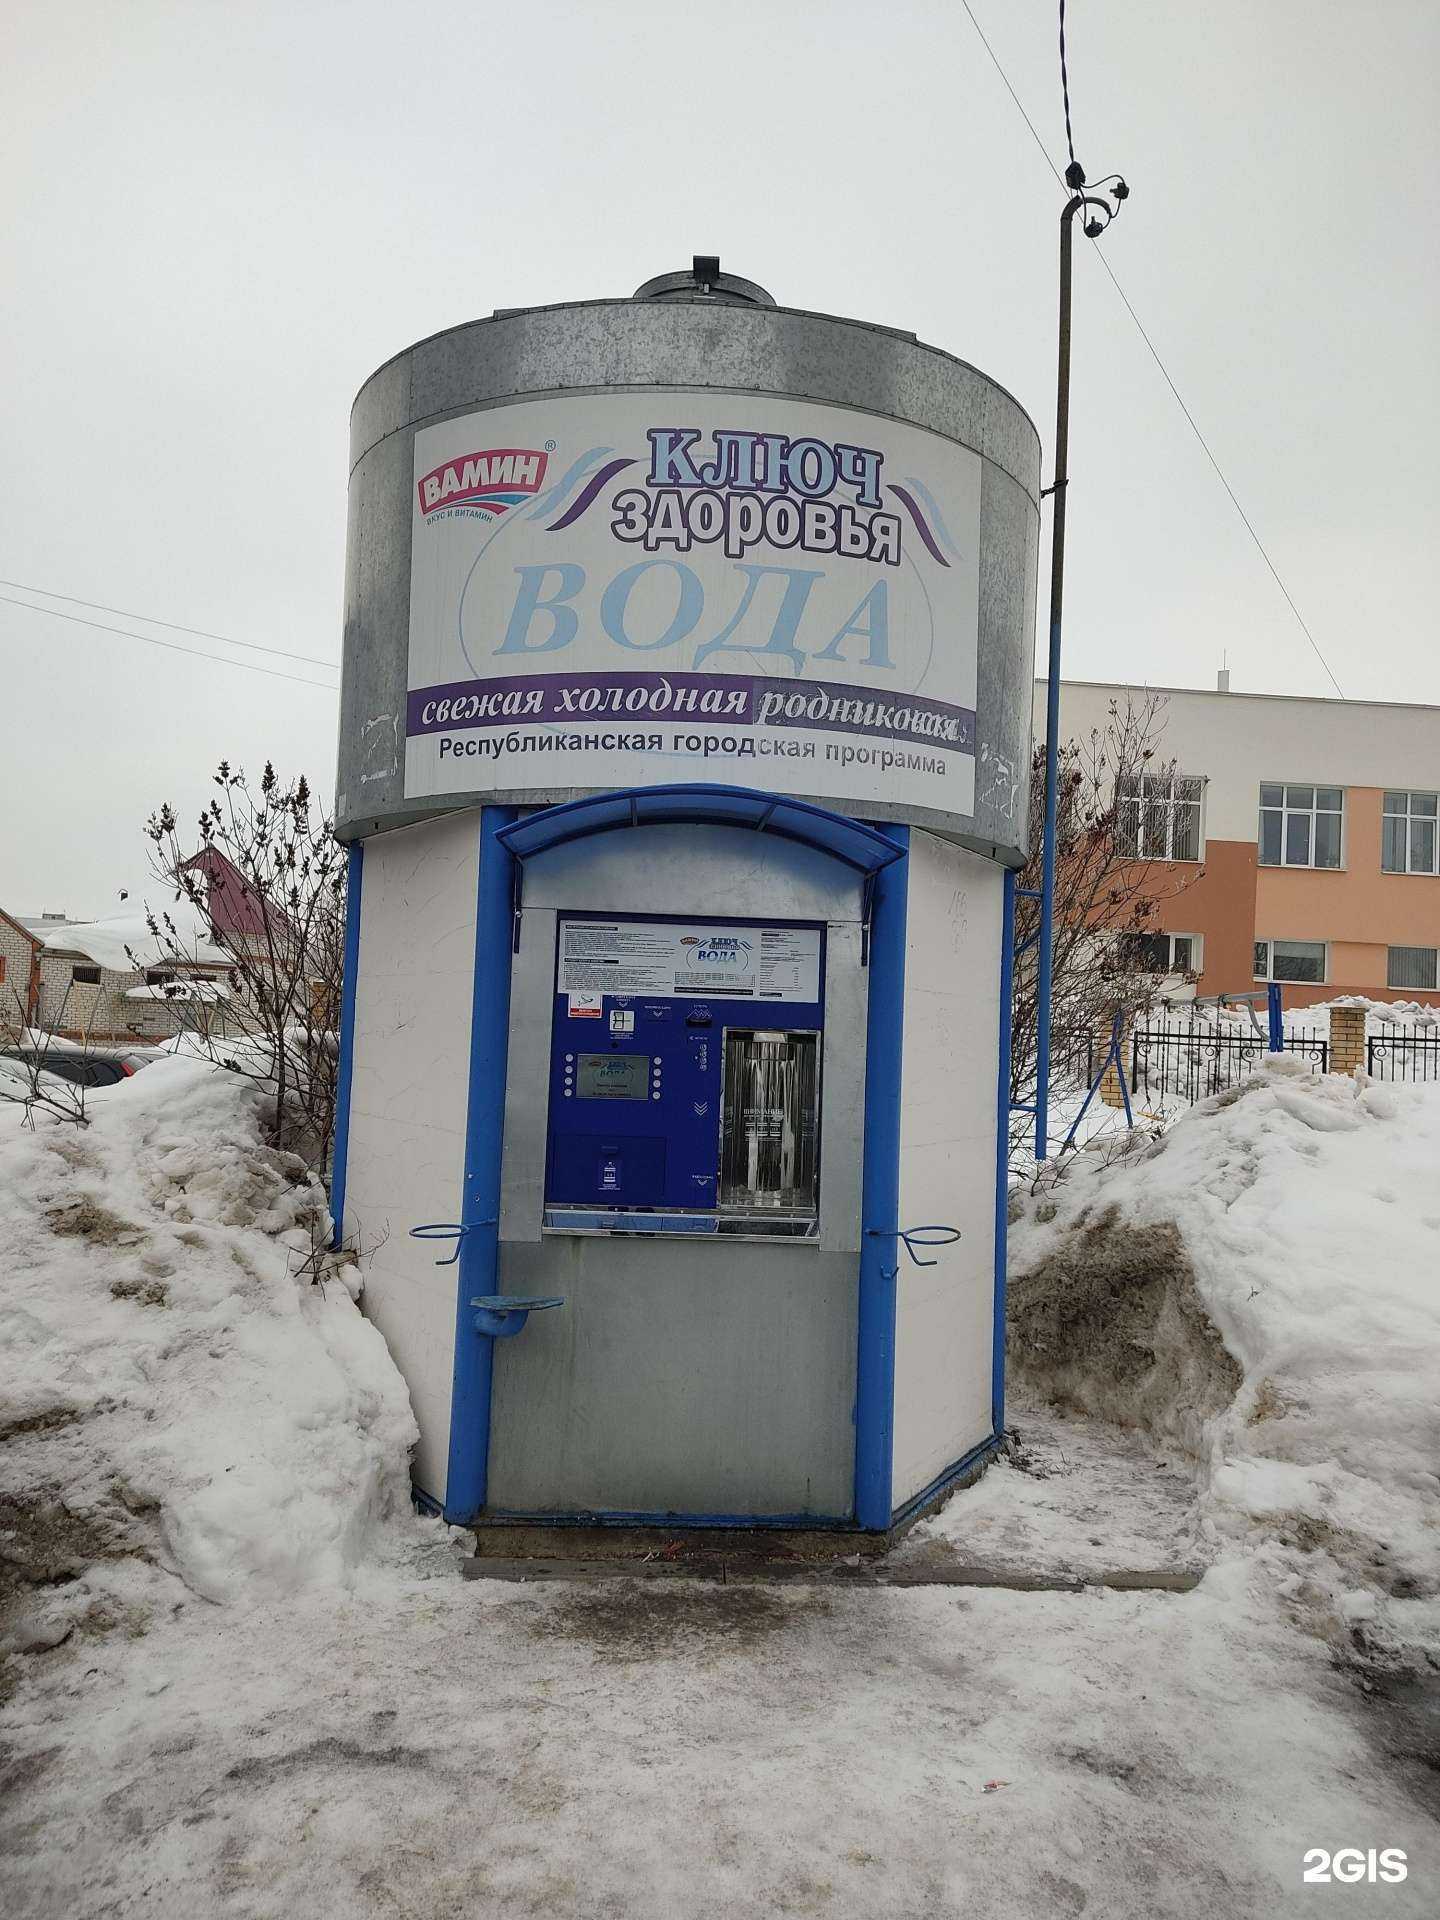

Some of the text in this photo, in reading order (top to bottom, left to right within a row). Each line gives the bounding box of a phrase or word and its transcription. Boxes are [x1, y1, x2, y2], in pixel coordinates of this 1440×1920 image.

[423, 455, 540, 508] ВАМИН
[646, 428, 885, 509] КЛЮЧ
[455, 509, 494, 524] ВИТАМИН
[491, 559, 897, 677] ВОДА
[421, 689, 545, 726] свежая
[553, 677, 748, 714] холодная
[438, 731, 947, 777] Республиканская городская программа
